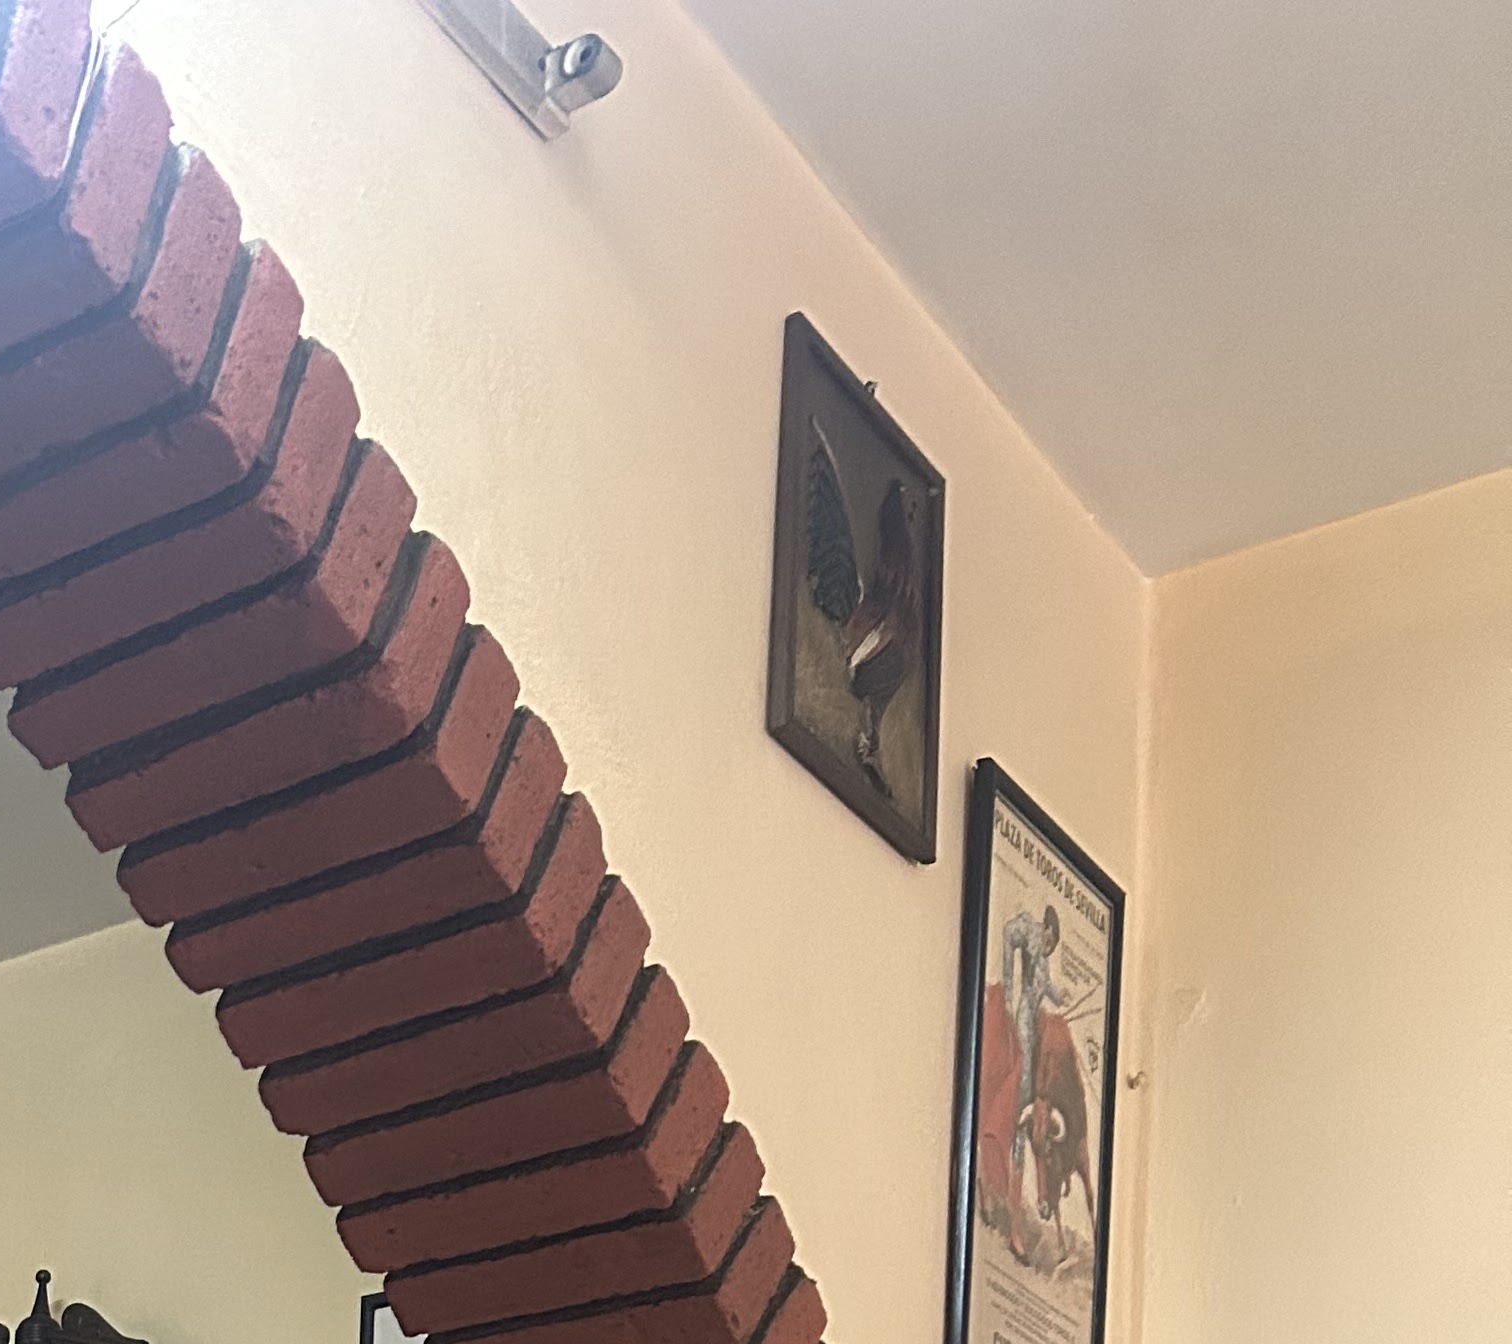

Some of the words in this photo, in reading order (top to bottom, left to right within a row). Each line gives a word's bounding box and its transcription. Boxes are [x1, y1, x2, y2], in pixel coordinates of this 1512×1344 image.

[995, 809, 1021, 852] PLAZA
[1023, 838, 1035, 865] DE
[1036, 849, 1063, 892] TOROS
[1064, 877, 1075, 905] DE
[1076, 890, 1106, 934] SEVILLA
